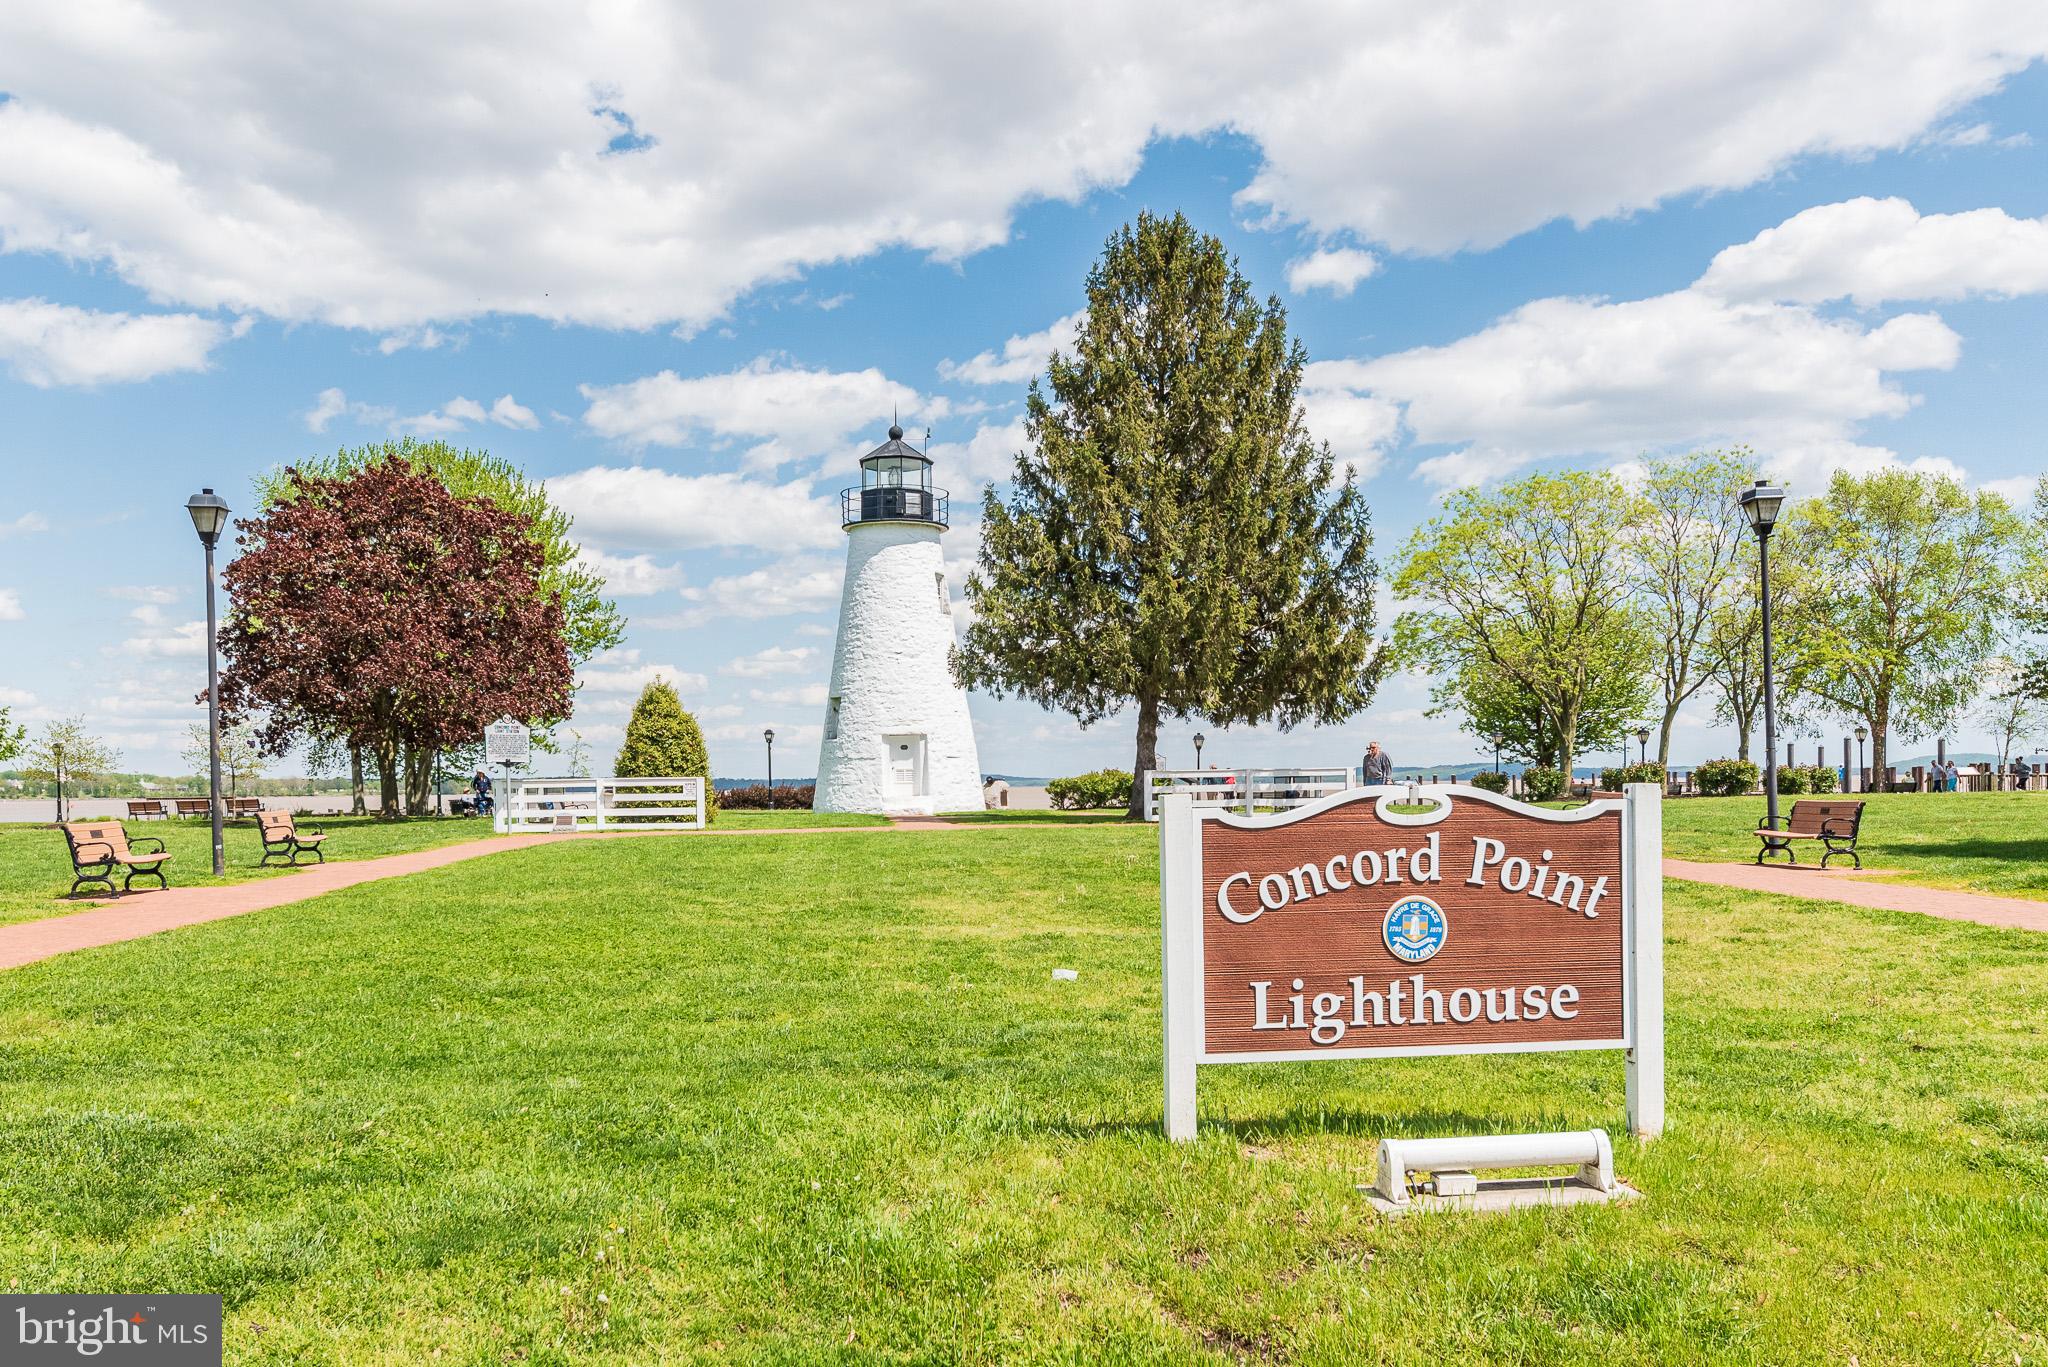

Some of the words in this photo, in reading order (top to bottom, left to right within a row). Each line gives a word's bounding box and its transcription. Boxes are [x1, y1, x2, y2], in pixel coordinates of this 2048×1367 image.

[1217, 831, 1443, 924] Concord
[1465, 835, 1609, 918] Point
[1391, 904, 1409, 923] HAVRE
[1421, 904, 1441, 924] GRACE
[1393, 942, 1436, 958] MARYLAND
[1249, 973, 1580, 1045] Lighthouse
